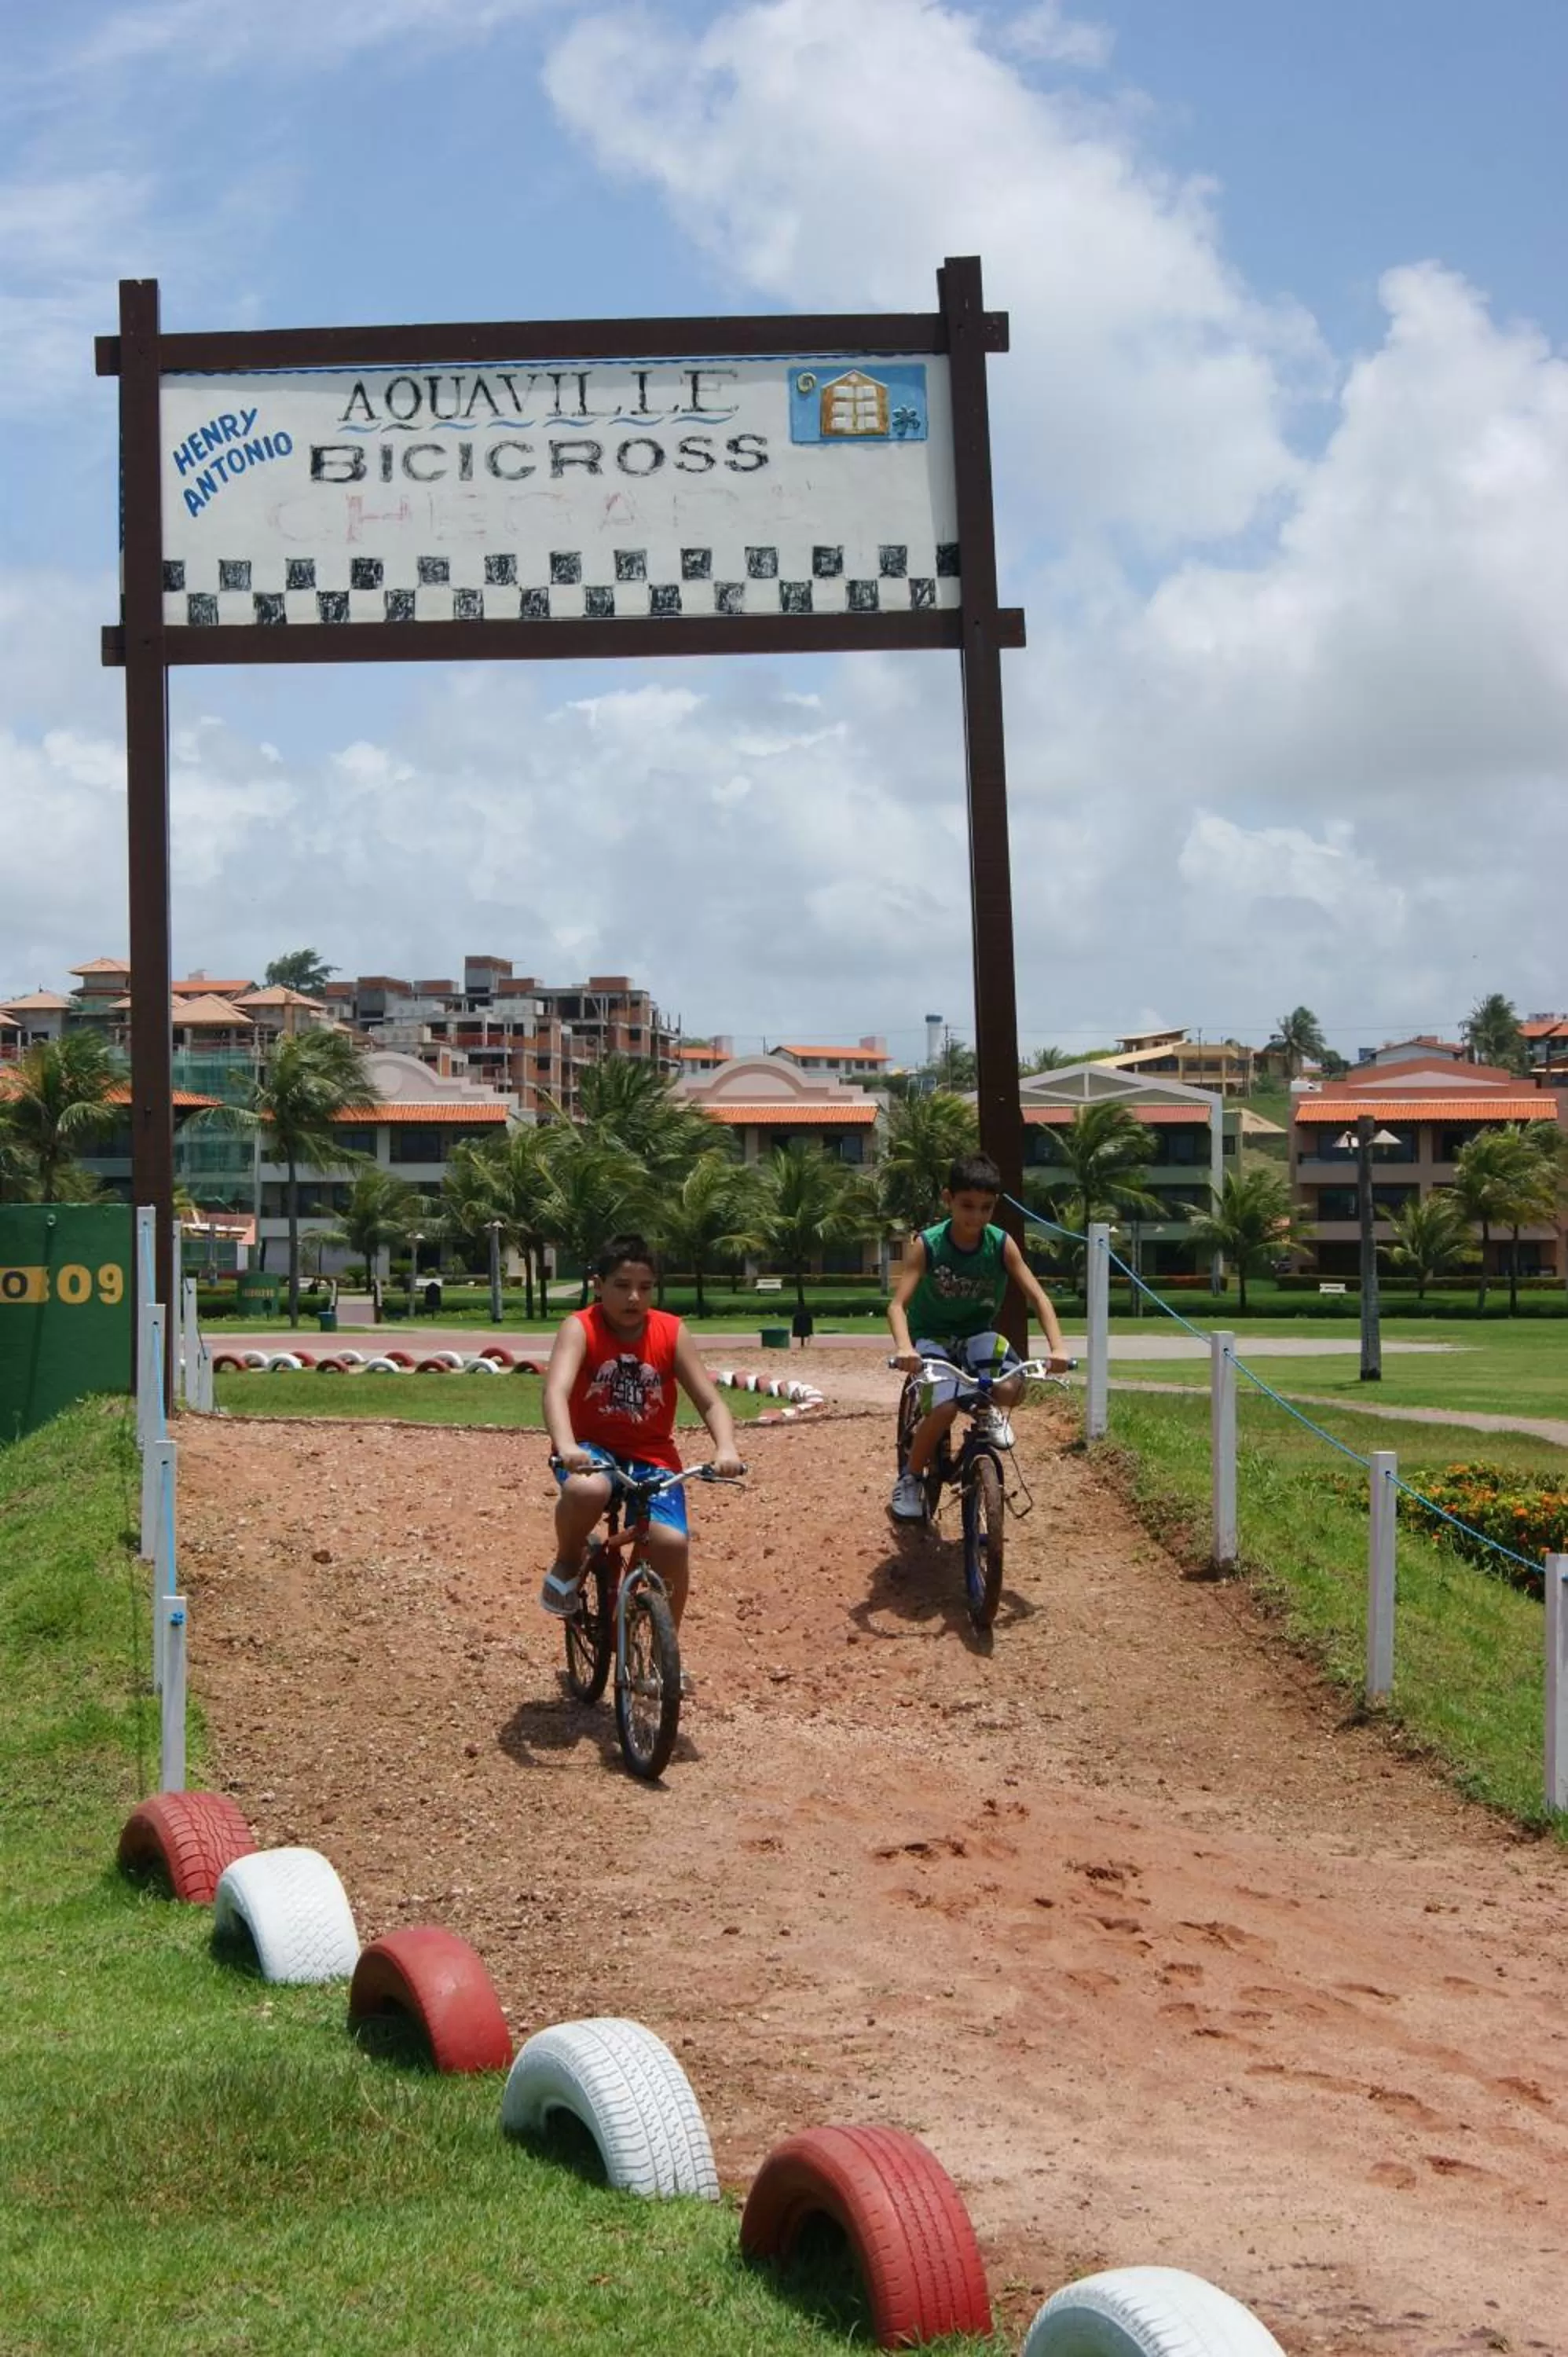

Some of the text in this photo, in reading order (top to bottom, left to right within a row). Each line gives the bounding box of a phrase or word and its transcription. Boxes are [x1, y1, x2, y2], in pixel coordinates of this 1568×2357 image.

[337, 368, 739, 422] AQUAVILLE
[172, 407, 258, 476] HENRY
[310, 433, 771, 484] BICICROSS
[182, 431, 294, 518] ANTONIO
[56, 1263, 124, 1304] 09
